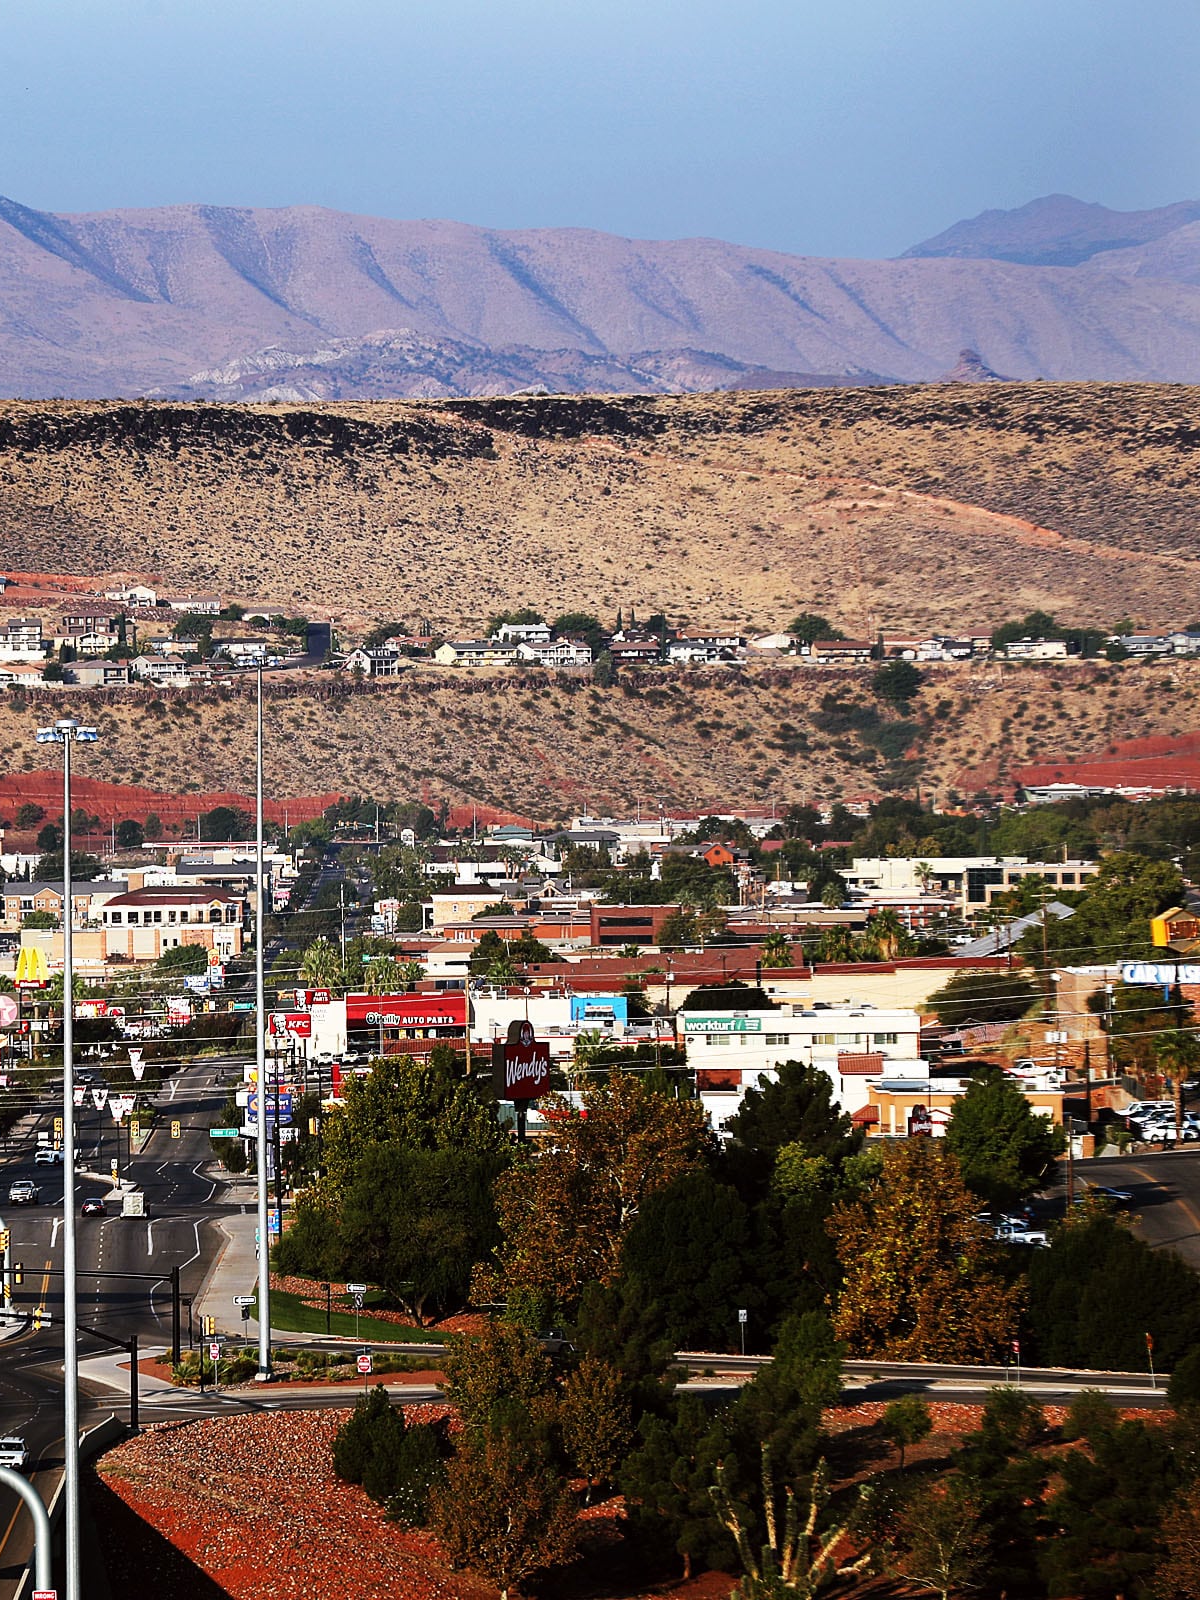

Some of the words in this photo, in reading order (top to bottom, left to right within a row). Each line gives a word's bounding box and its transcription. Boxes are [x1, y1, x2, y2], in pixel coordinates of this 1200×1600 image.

[1123, 964, 1158, 983] CAR
[287, 1020, 310, 1028] KFC
[366, 1012, 400, 1025] O'Reilly
[402, 1016, 424, 1024] AUTO
[426, 1016, 454, 1024] PARTS
[686, 1019, 736, 1031] workturf
[506, 1051, 548, 1088] Wendy's
